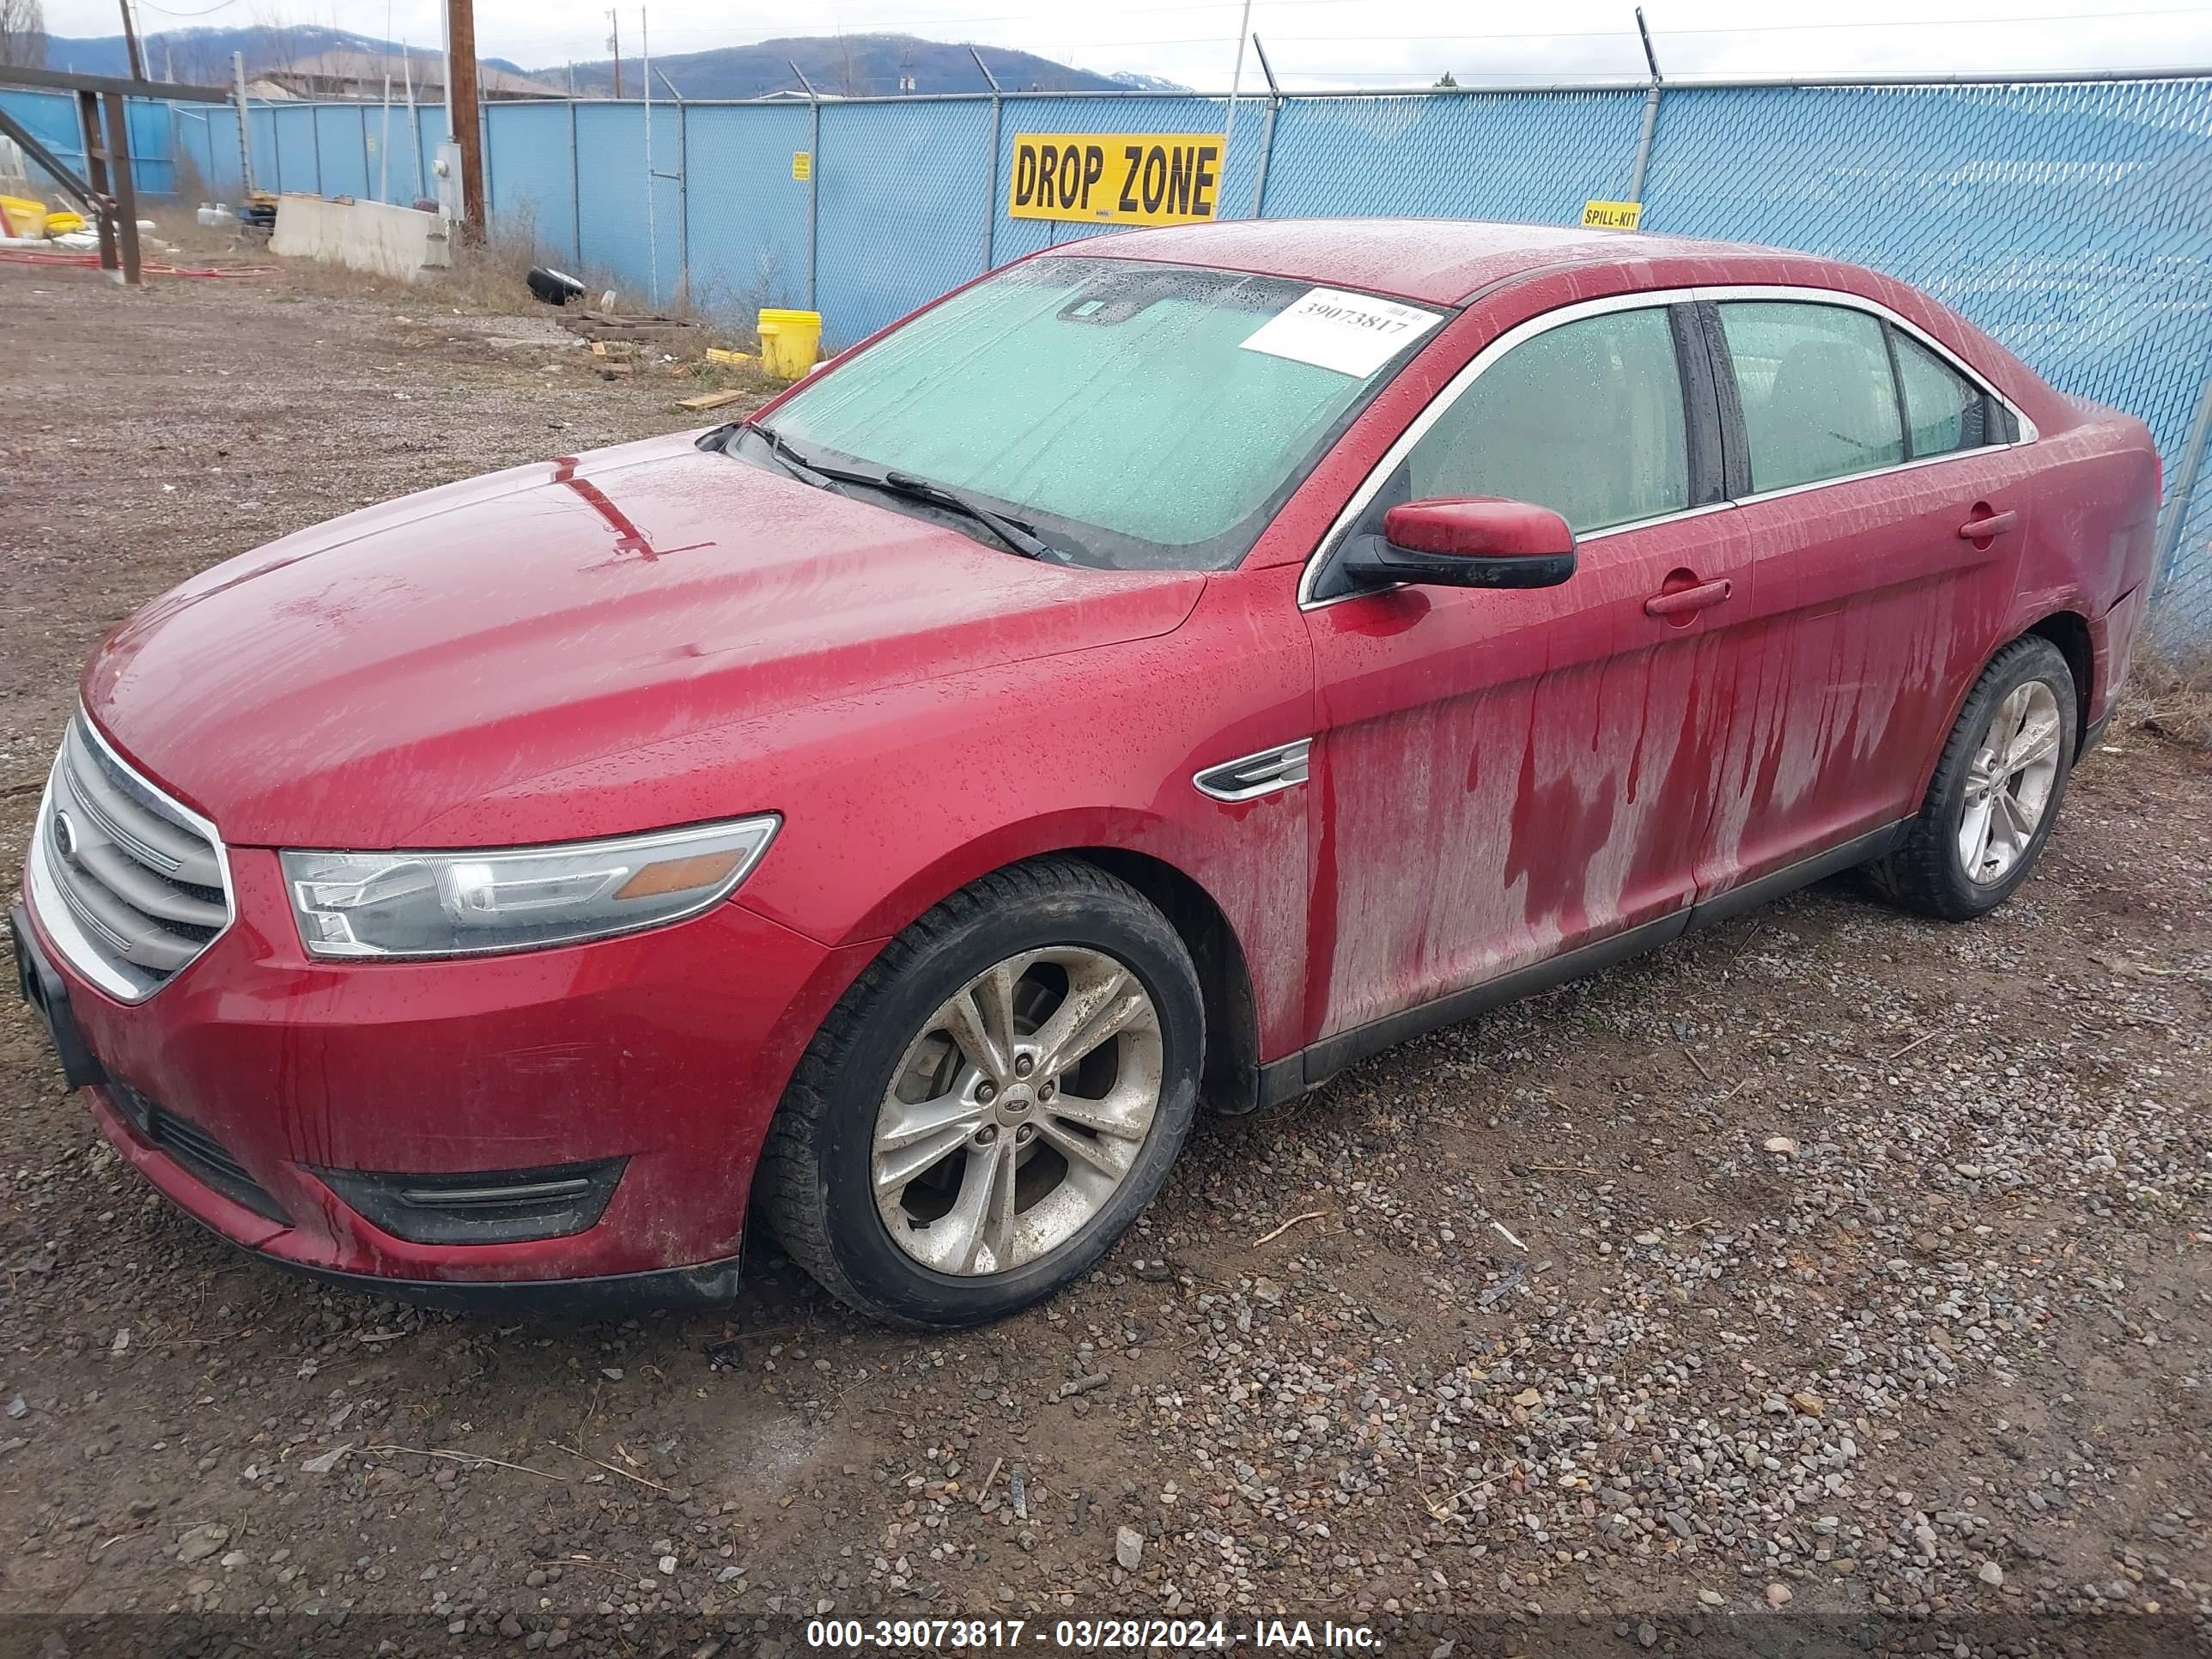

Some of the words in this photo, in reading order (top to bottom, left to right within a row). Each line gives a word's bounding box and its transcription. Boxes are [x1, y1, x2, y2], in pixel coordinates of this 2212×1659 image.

[1015, 143, 1104, 210] DROP
[1118, 144, 1218, 216] ZONE
[1584, 209, 1638, 228] SPILL-KIT
[1298, 302, 1409, 334] 39073817
